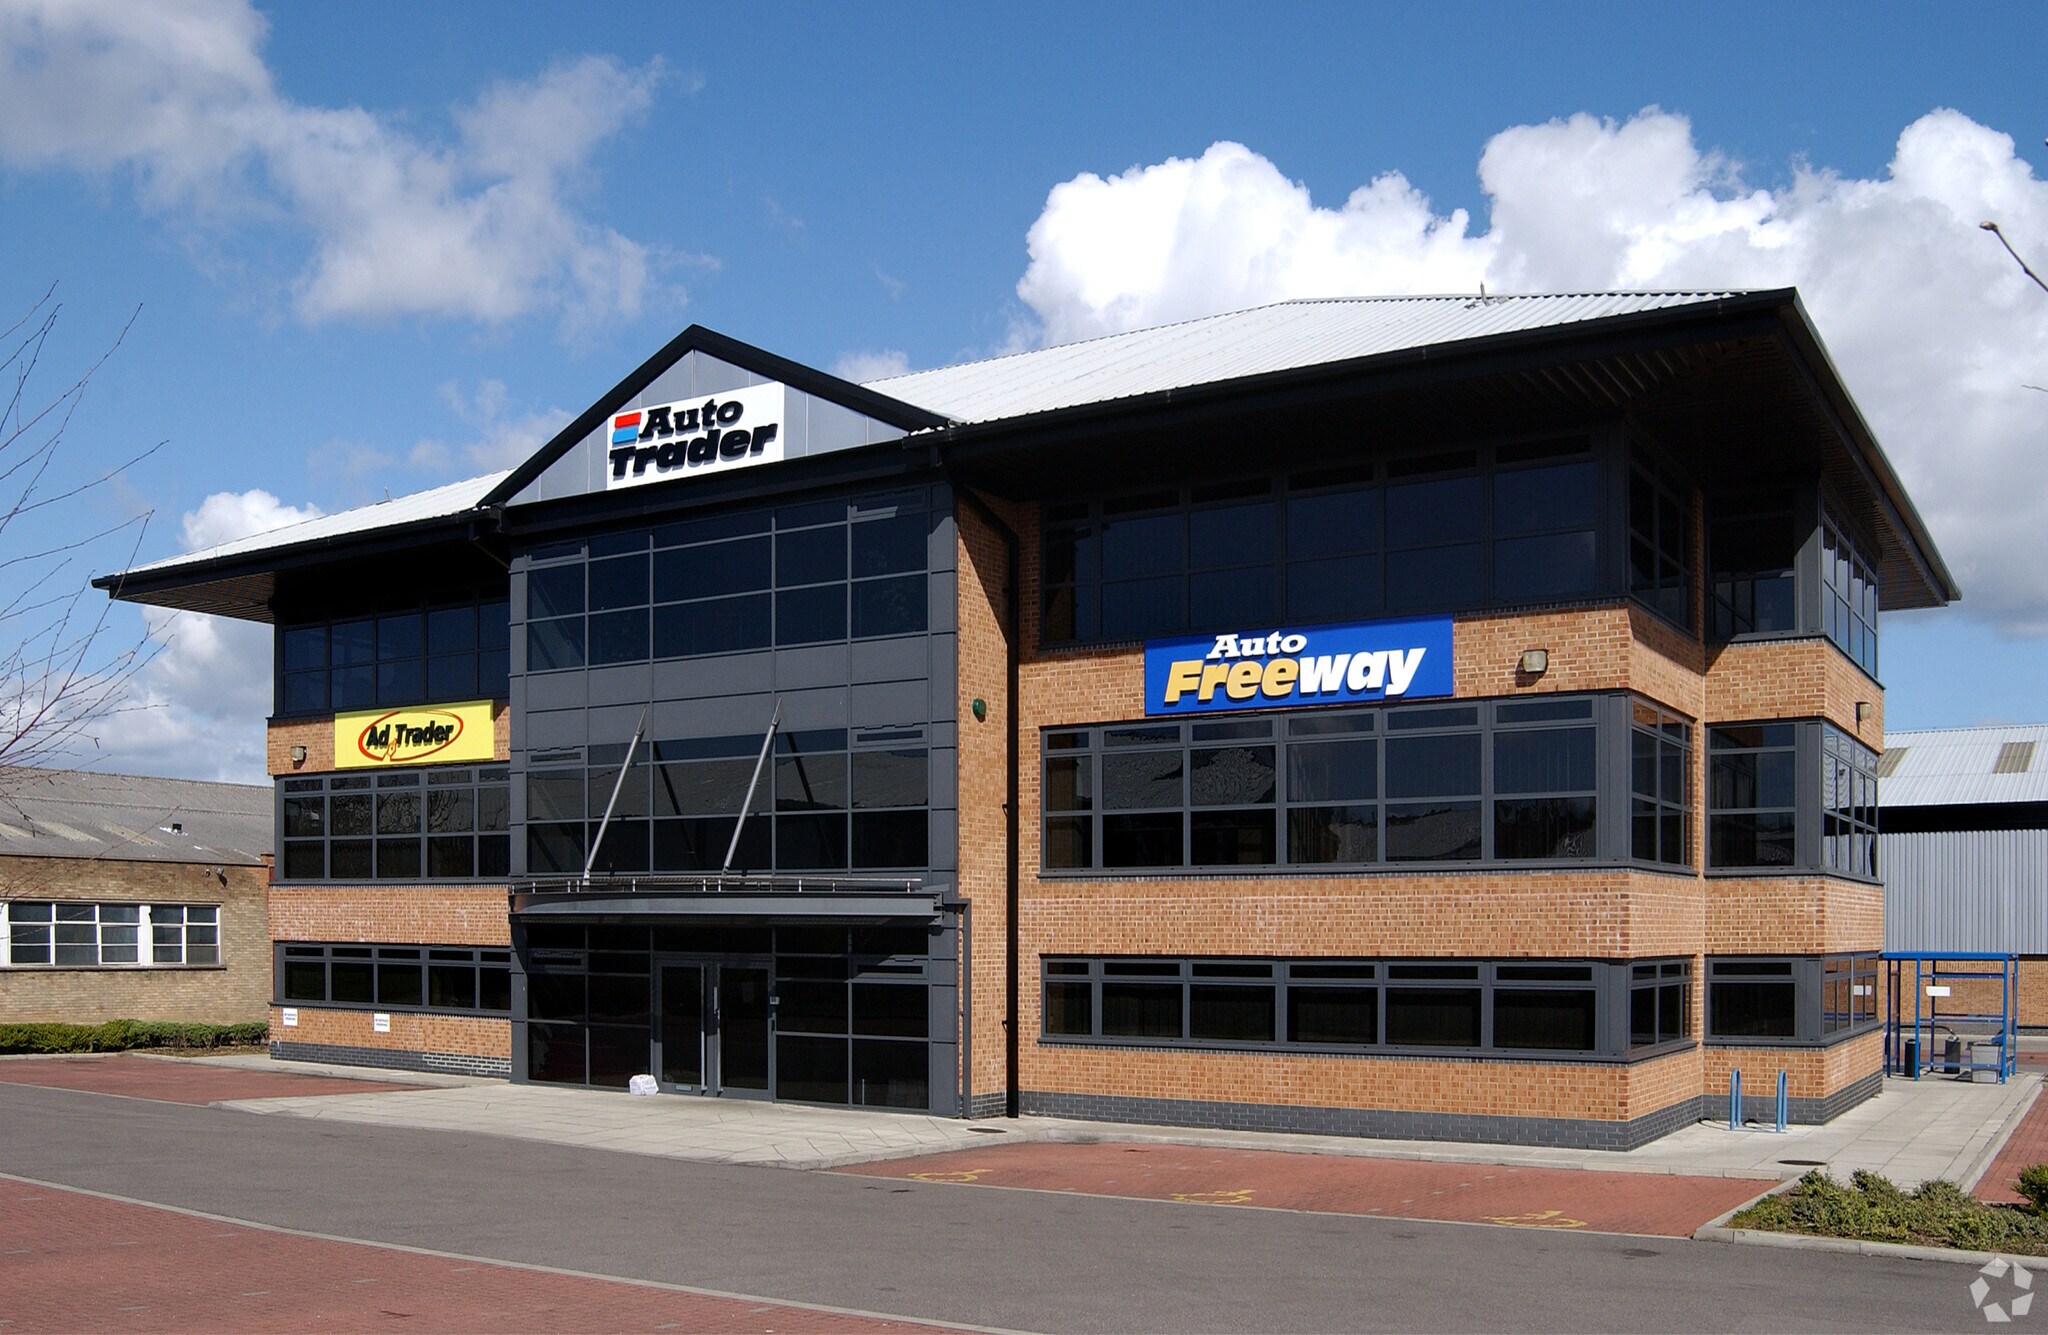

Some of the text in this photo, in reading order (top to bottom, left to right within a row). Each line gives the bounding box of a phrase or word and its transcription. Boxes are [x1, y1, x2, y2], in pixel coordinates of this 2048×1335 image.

[638, 398, 744, 439] Auto
[609, 423, 778, 478] Trader
[1206, 631, 1308, 660] Auto
[1164, 647, 1427, 703] Freeway
[366, 720, 455, 747] Ad Trader
